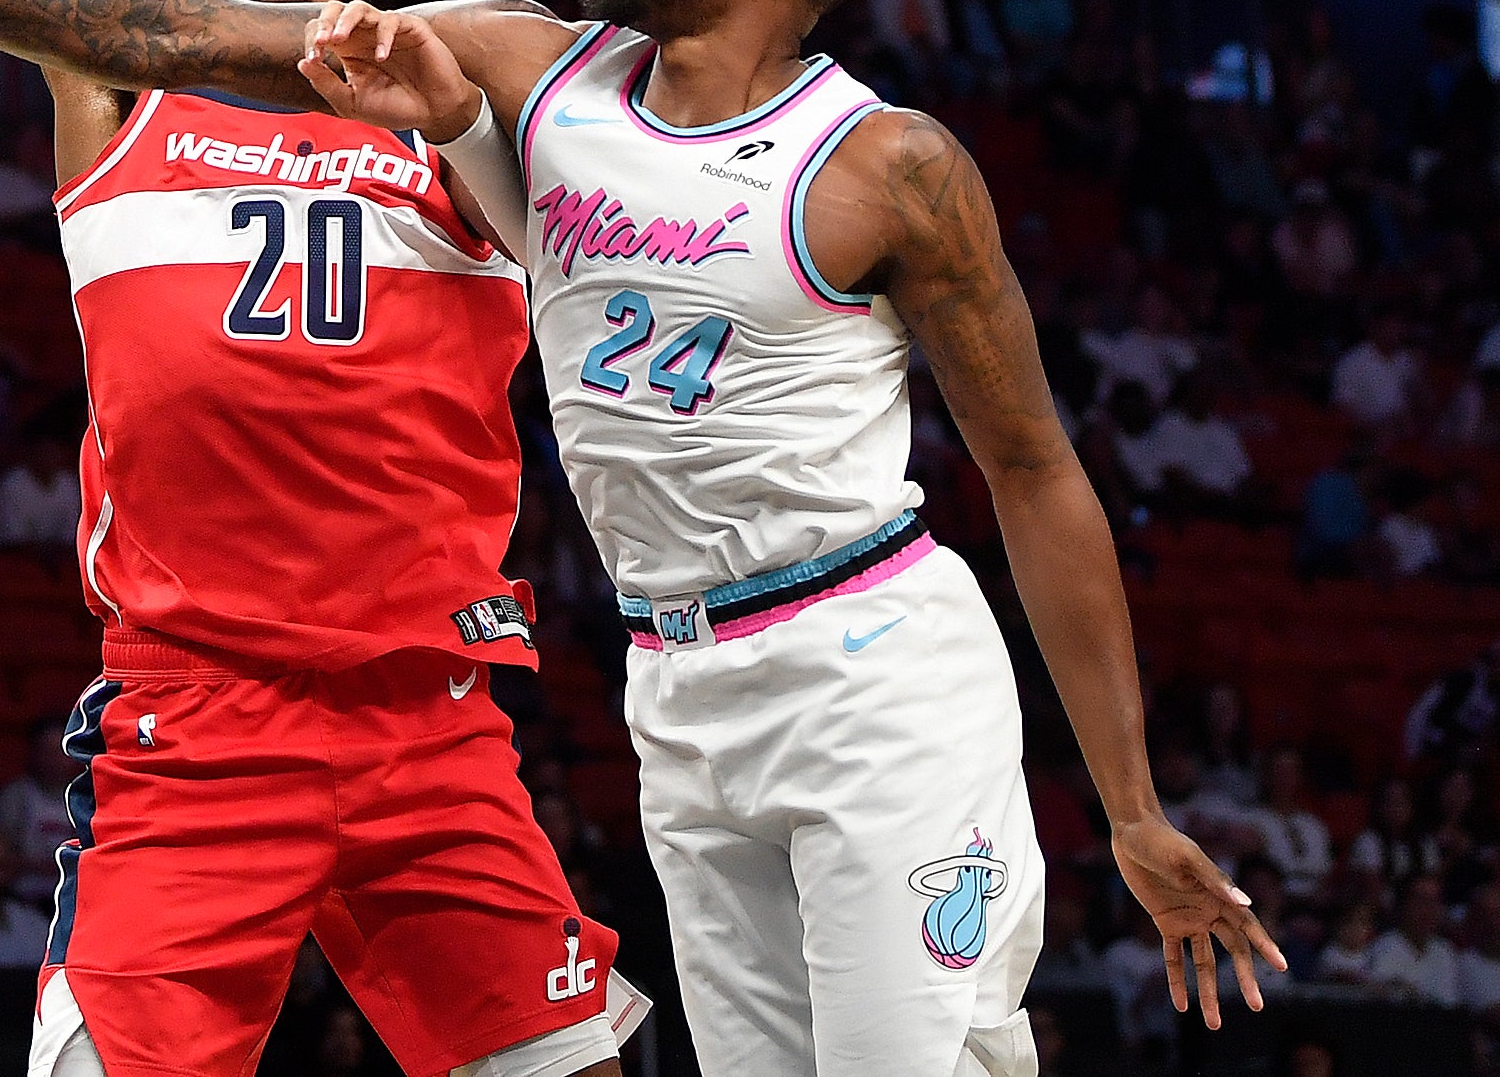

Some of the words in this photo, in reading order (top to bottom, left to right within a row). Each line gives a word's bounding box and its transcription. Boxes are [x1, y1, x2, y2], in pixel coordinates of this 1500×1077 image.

[165, 131, 433, 194] washington
[700, 162, 772, 192] Robinhood
[223, 194, 367, 346] 20
[533, 183, 751, 280] Miami
[580, 289, 735, 416] 24
[546, 935, 597, 1002] dc
